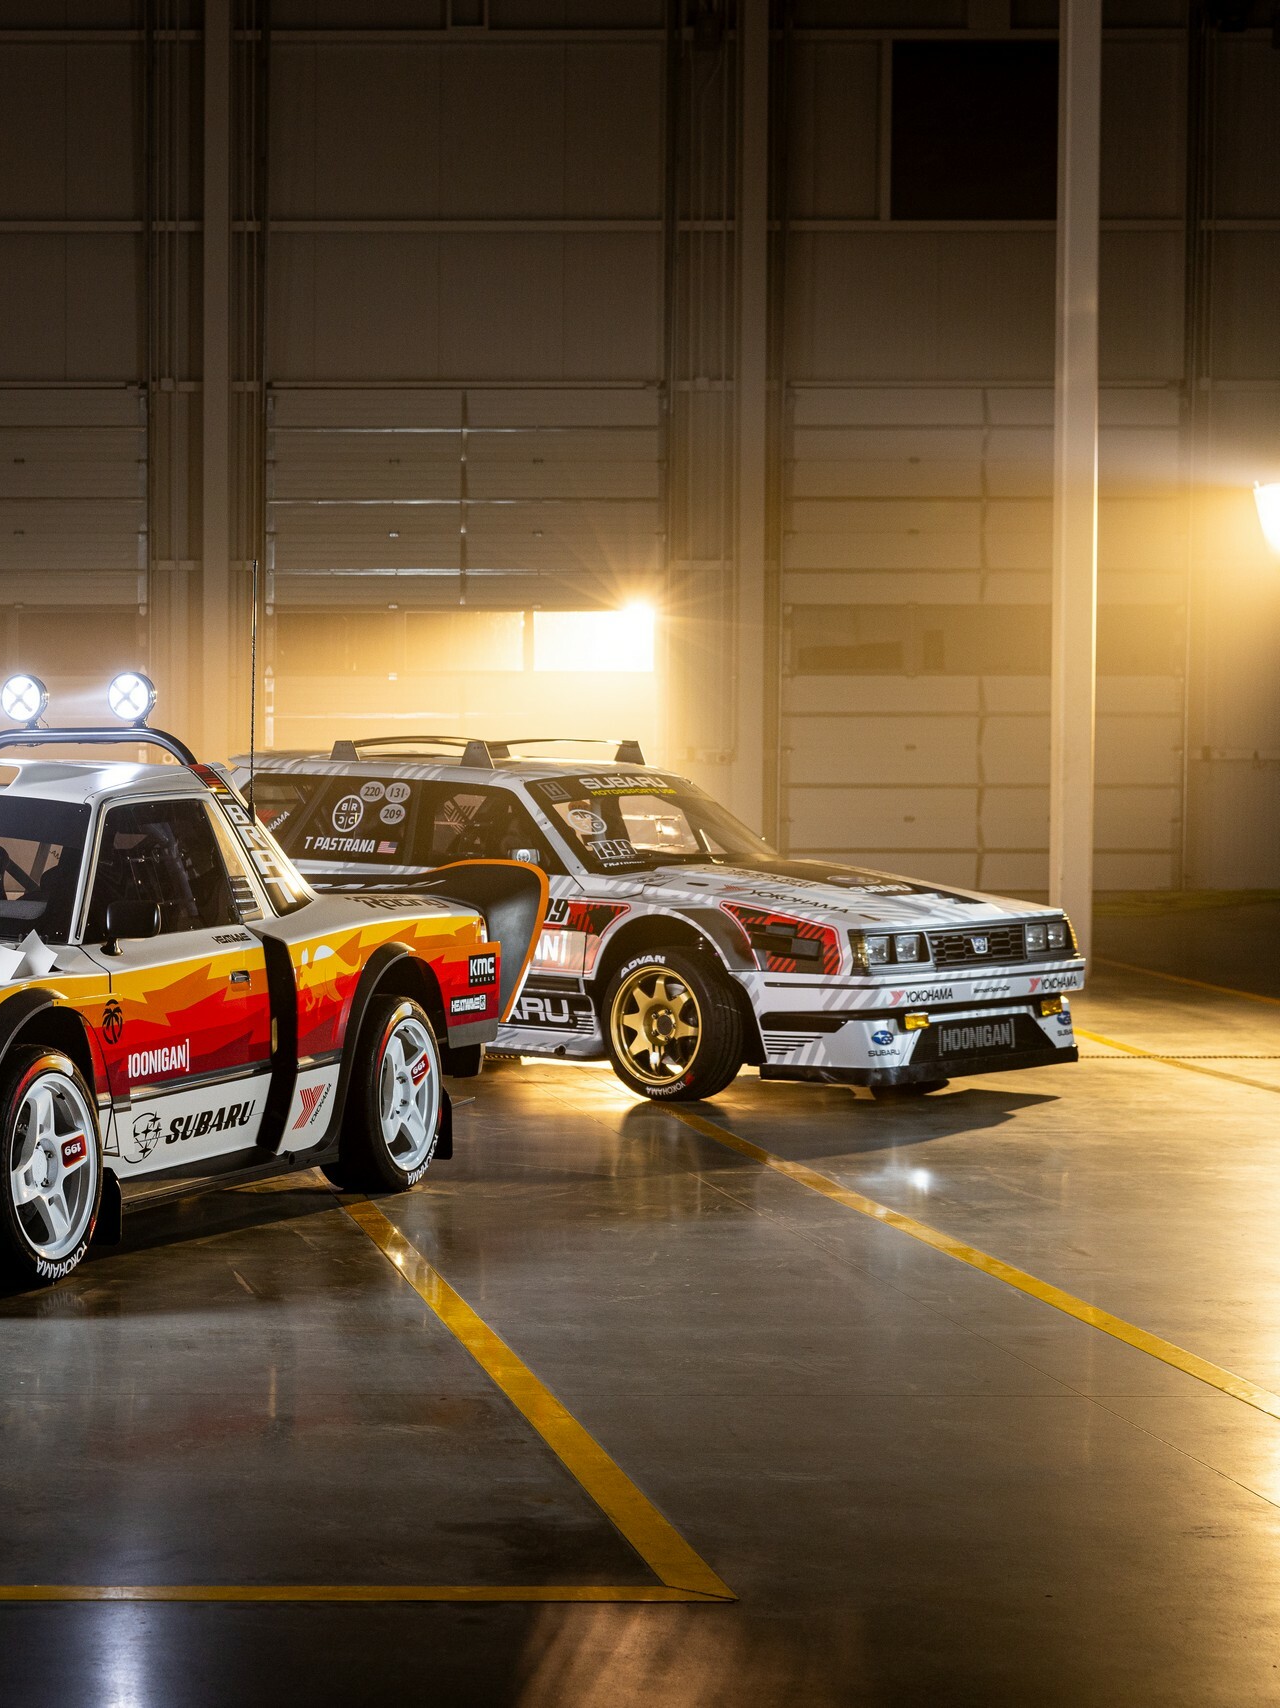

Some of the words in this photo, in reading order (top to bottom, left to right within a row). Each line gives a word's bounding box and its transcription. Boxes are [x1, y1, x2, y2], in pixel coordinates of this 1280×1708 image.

[579, 777, 669, 790] SUBARU
[364, 786, 380, 797] 220
[389, 787, 404, 798] 131
[591, 788, 659, 796] MOTORSPORTS
[383, 808, 401, 819] 209
[305, 836, 313, 849] T
[314, 837, 376, 853] PASTRANA
[587, 839, 638, 860] 199
[224, 804, 297, 904] BRAT
[849, 884, 913, 894] SUBARU
[355, 896, 450, 910] Racing
[749, 889, 849, 914] YOKOHAMA
[470, 957, 495, 977] KMC
[621, 955, 666, 979] ADVAN
[1040, 975, 1078, 990] YOKOHAMA
[906, 987, 953, 1003] YOKOHAMA
[938, 1018, 1016, 1056] [HOONIGAN]
[868, 1049, 901, 1058] SUBARU
[645, 1082, 687, 1096] YOKOHAMA
[165, 1099, 256, 1145] SUBARU
[36, 1240, 88, 1279] YOKOHAMA
